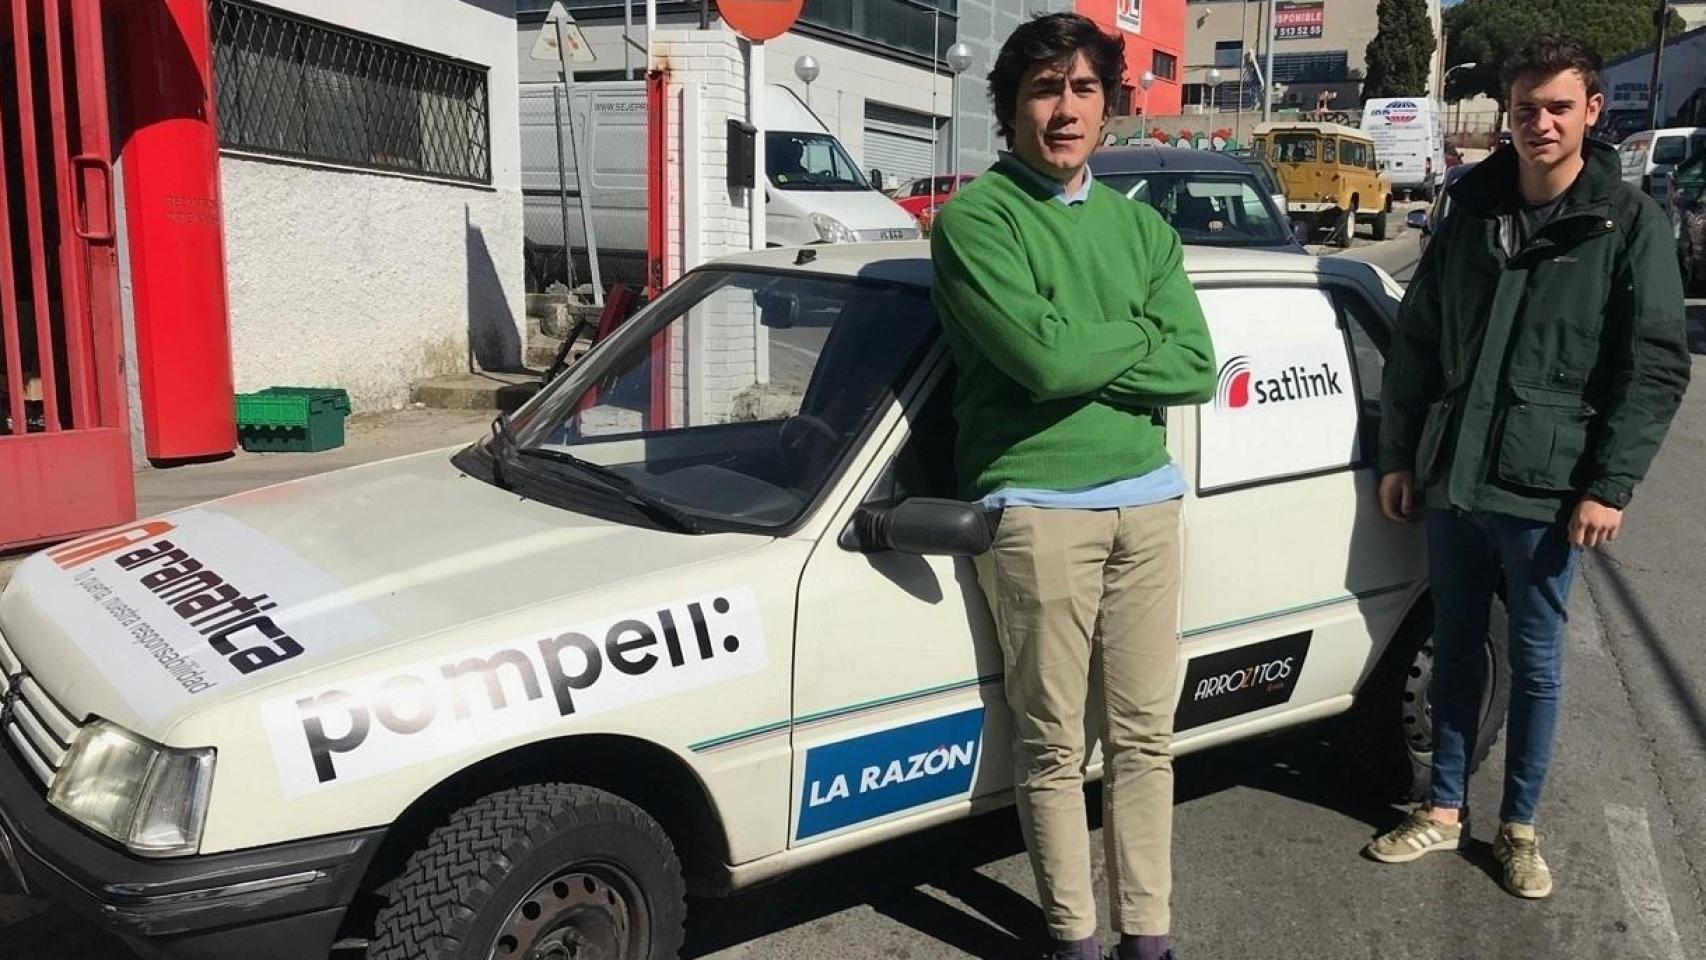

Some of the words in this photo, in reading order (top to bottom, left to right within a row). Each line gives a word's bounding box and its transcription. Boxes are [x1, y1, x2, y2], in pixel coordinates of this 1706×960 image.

[1277, 11, 1322, 23] SPONIBLE
[1254, 363, 1343, 404] satlink
[102, 597, 141, 627] nuestra
[130, 621, 218, 695] responsabilidad
[809, 773, 850, 807] LA
[859, 741, 975, 793] RAZÓN
